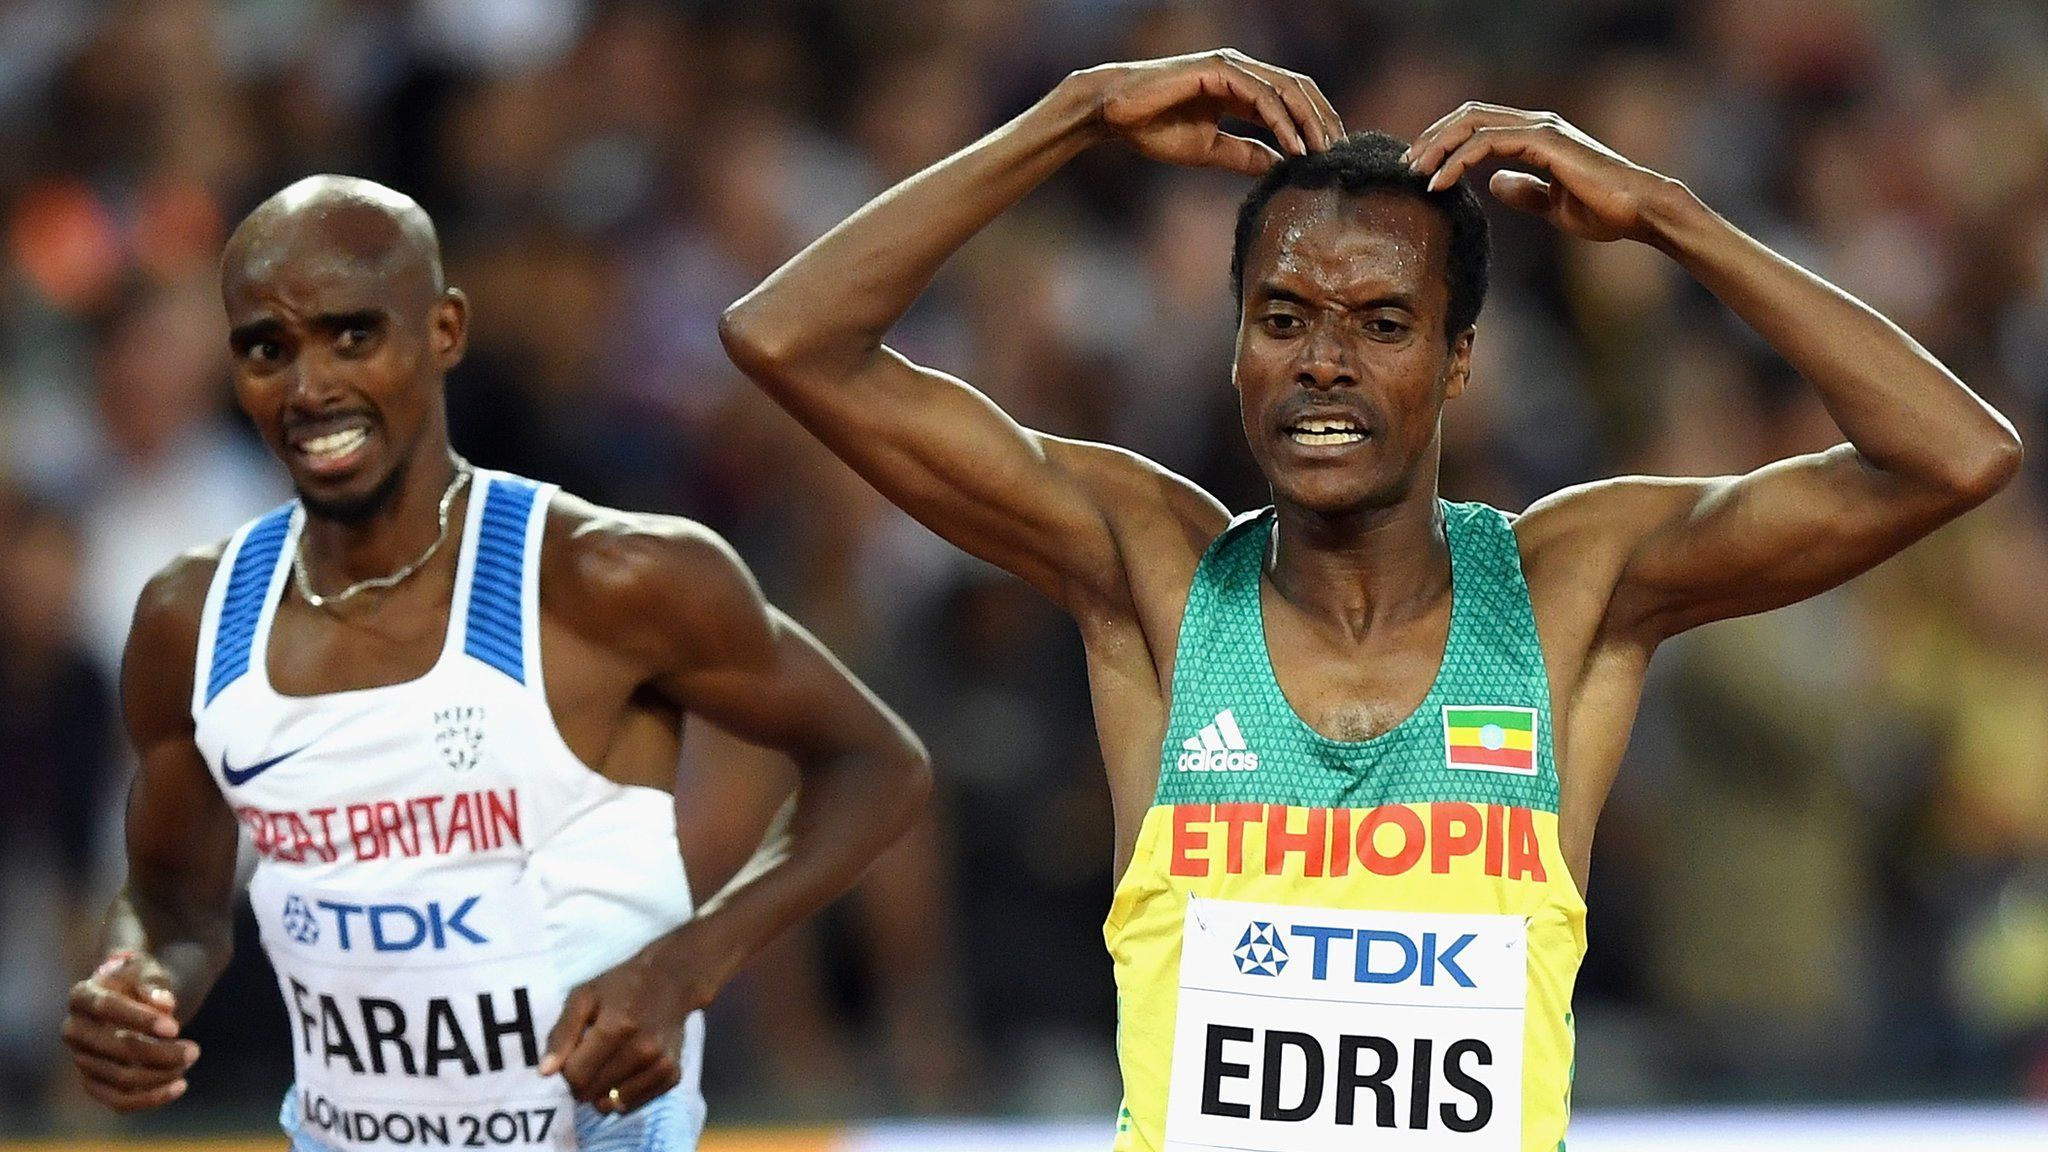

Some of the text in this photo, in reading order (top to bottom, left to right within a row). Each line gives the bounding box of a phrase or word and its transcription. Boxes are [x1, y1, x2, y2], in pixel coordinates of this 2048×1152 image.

[1177, 748, 1260, 773] adidas
[345, 786, 522, 862] BRITAIN
[1169, 801, 1548, 884] ETHIOPIA
[318, 894, 490, 953] TDK
[1290, 924, 1479, 990] TDK
[288, 974, 541, 1078] FARAH
[1200, 1022, 1494, 1134] EDRIS
[302, 1087, 559, 1149] LONDON 2017
